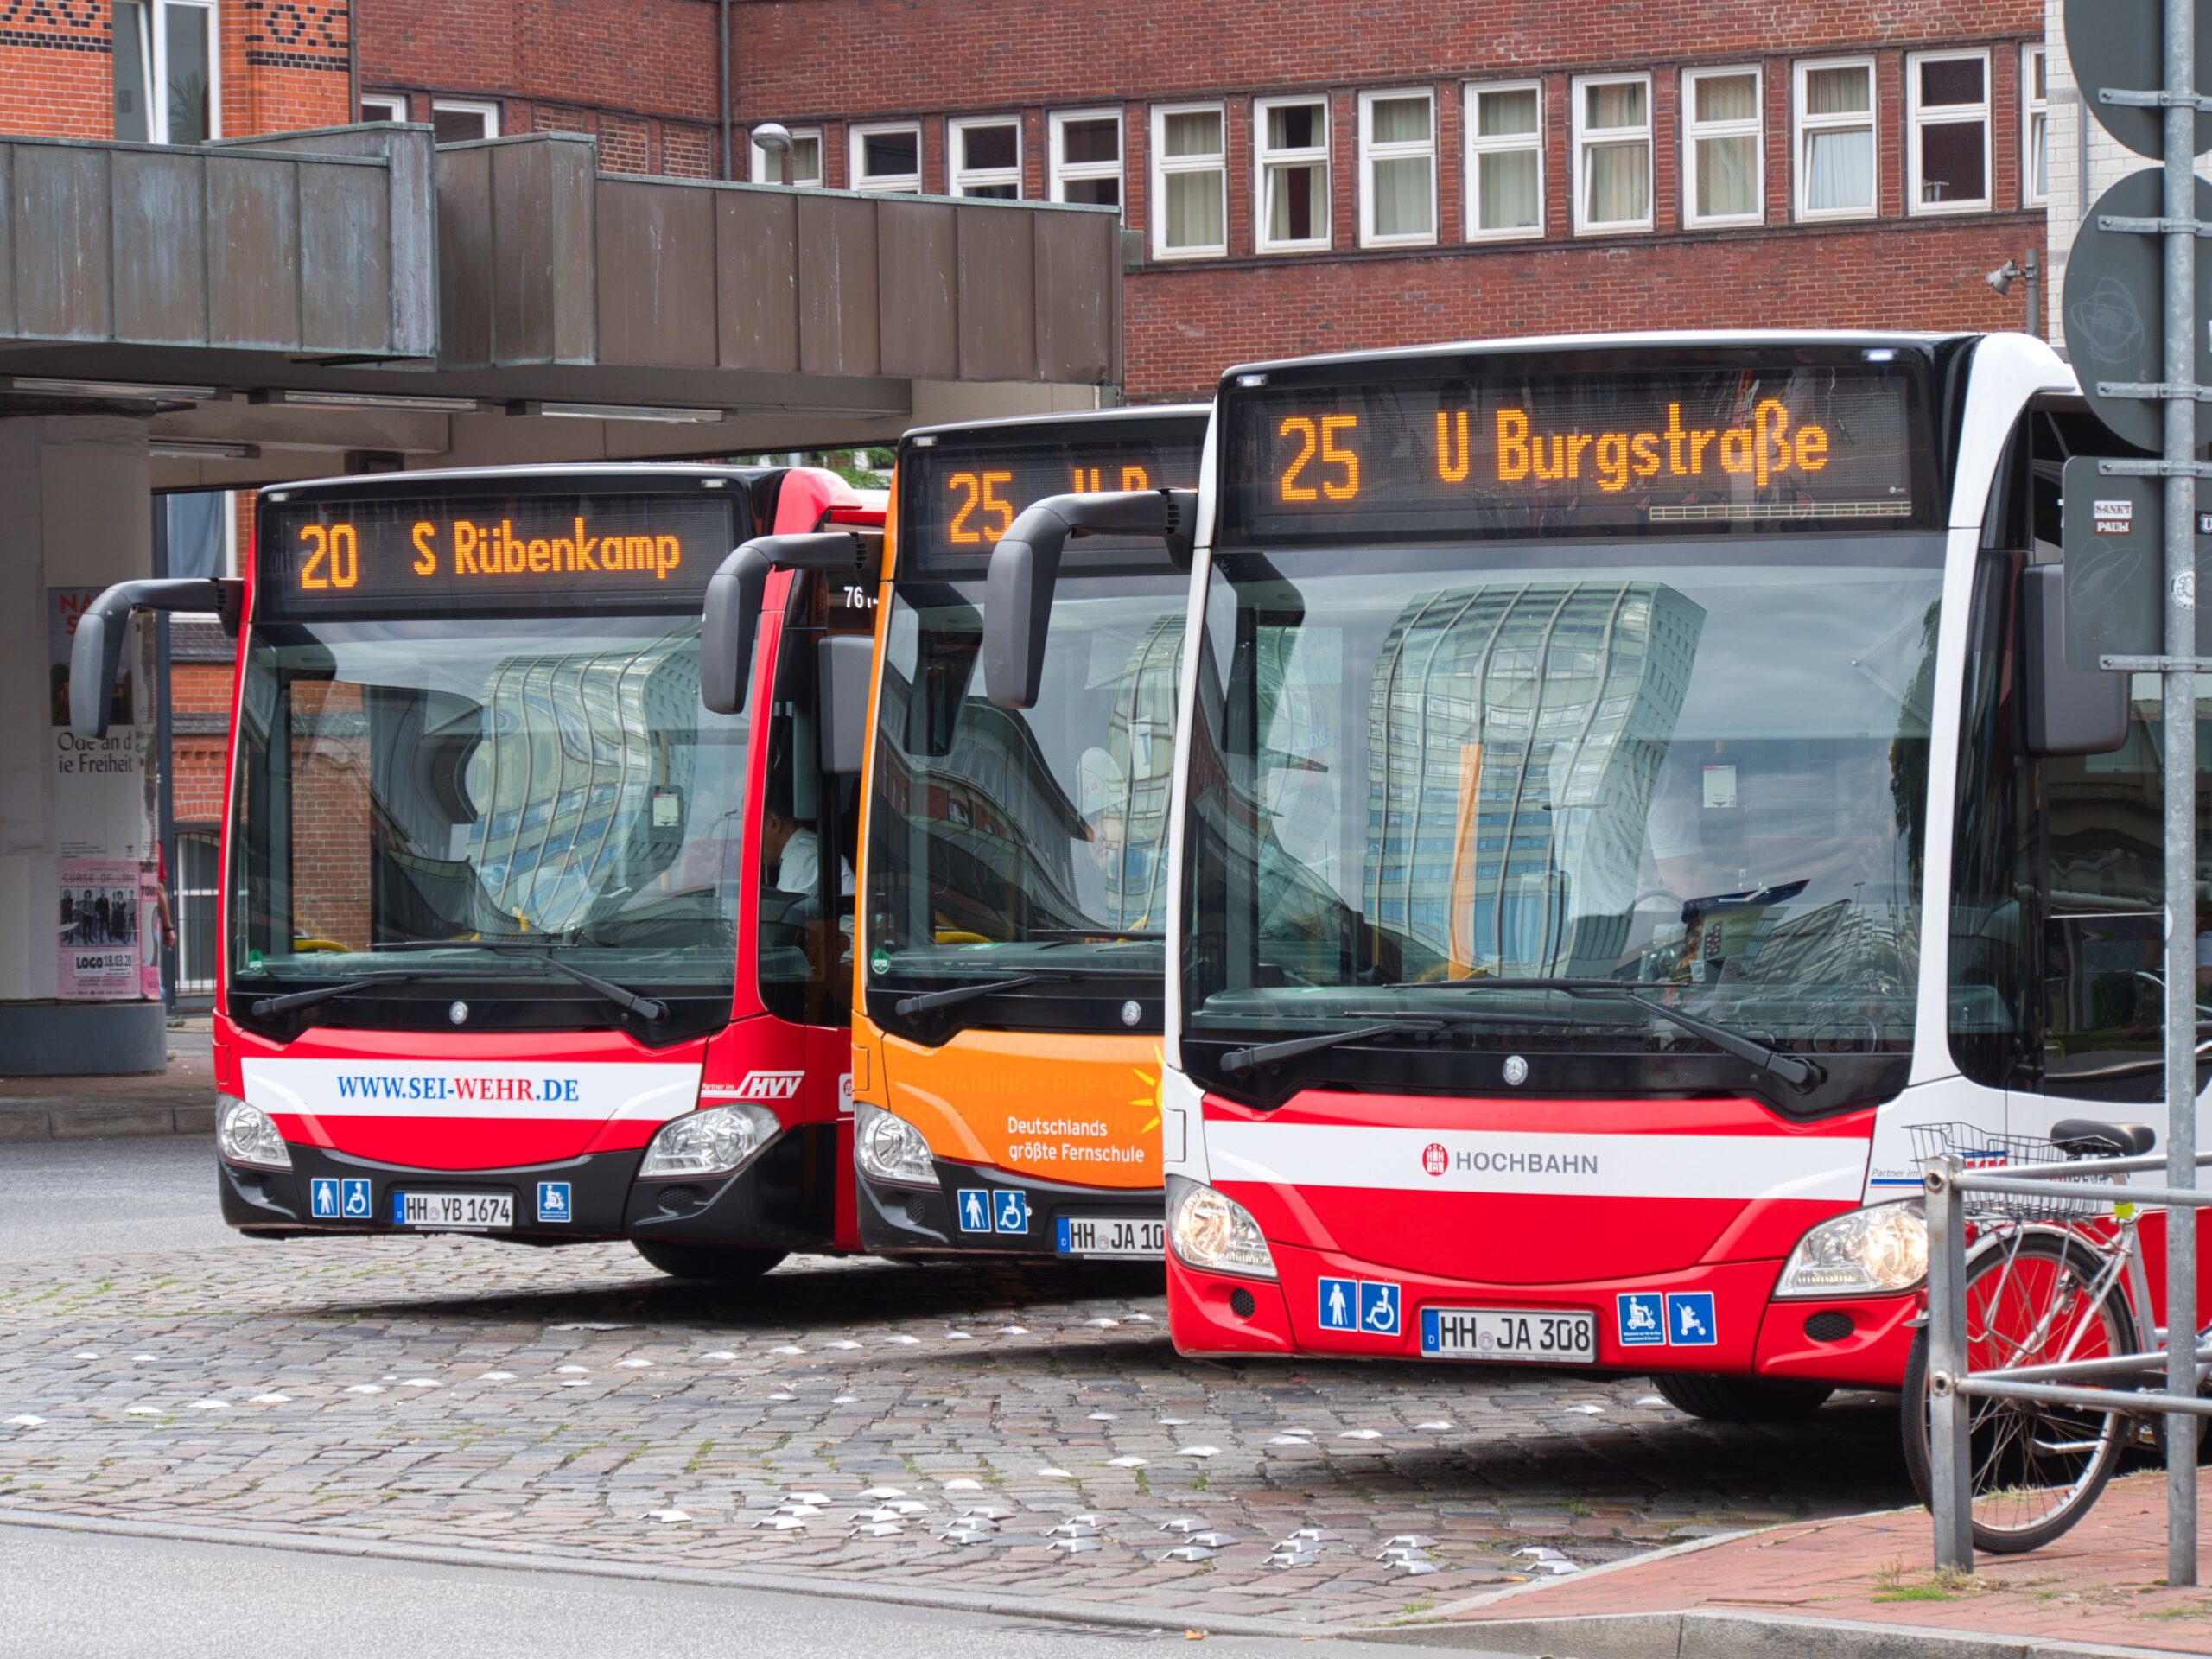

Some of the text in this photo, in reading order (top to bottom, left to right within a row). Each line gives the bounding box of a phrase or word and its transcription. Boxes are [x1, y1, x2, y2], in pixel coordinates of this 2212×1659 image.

[1280, 398, 1829, 501] 25 U Burgstraße
[949, 471, 1014, 543] 25
[2095, 505, 2132, 514] SANKT
[300, 517, 681, 589] 20 S Rübenkamp
[58, 753, 133, 773] ie Freiheit
[75, 957, 104, 969] LOGO
[337, 1076, 580, 1102] WWW.SEI-WEHR.DE
[747, 1077, 802, 1096] HVV
[1007, 1116, 1108, 1137] Deutschlands
[1008, 1144, 1058, 1163] größte
[1061, 1145, 1145, 1163] Fernschule
[1456, 1152, 1599, 1174] HOCHBAHN
[1872, 1168, 1919, 1179] Partner im
[405, 1197, 510, 1223] HH YB 1674
[1070, 1223, 1095, 1249] HH
[1110, 1224, 1135, 1249] JA
[1428, 1335, 1435, 1344] D
[1440, 1316, 1591, 1351] HH JA 308
